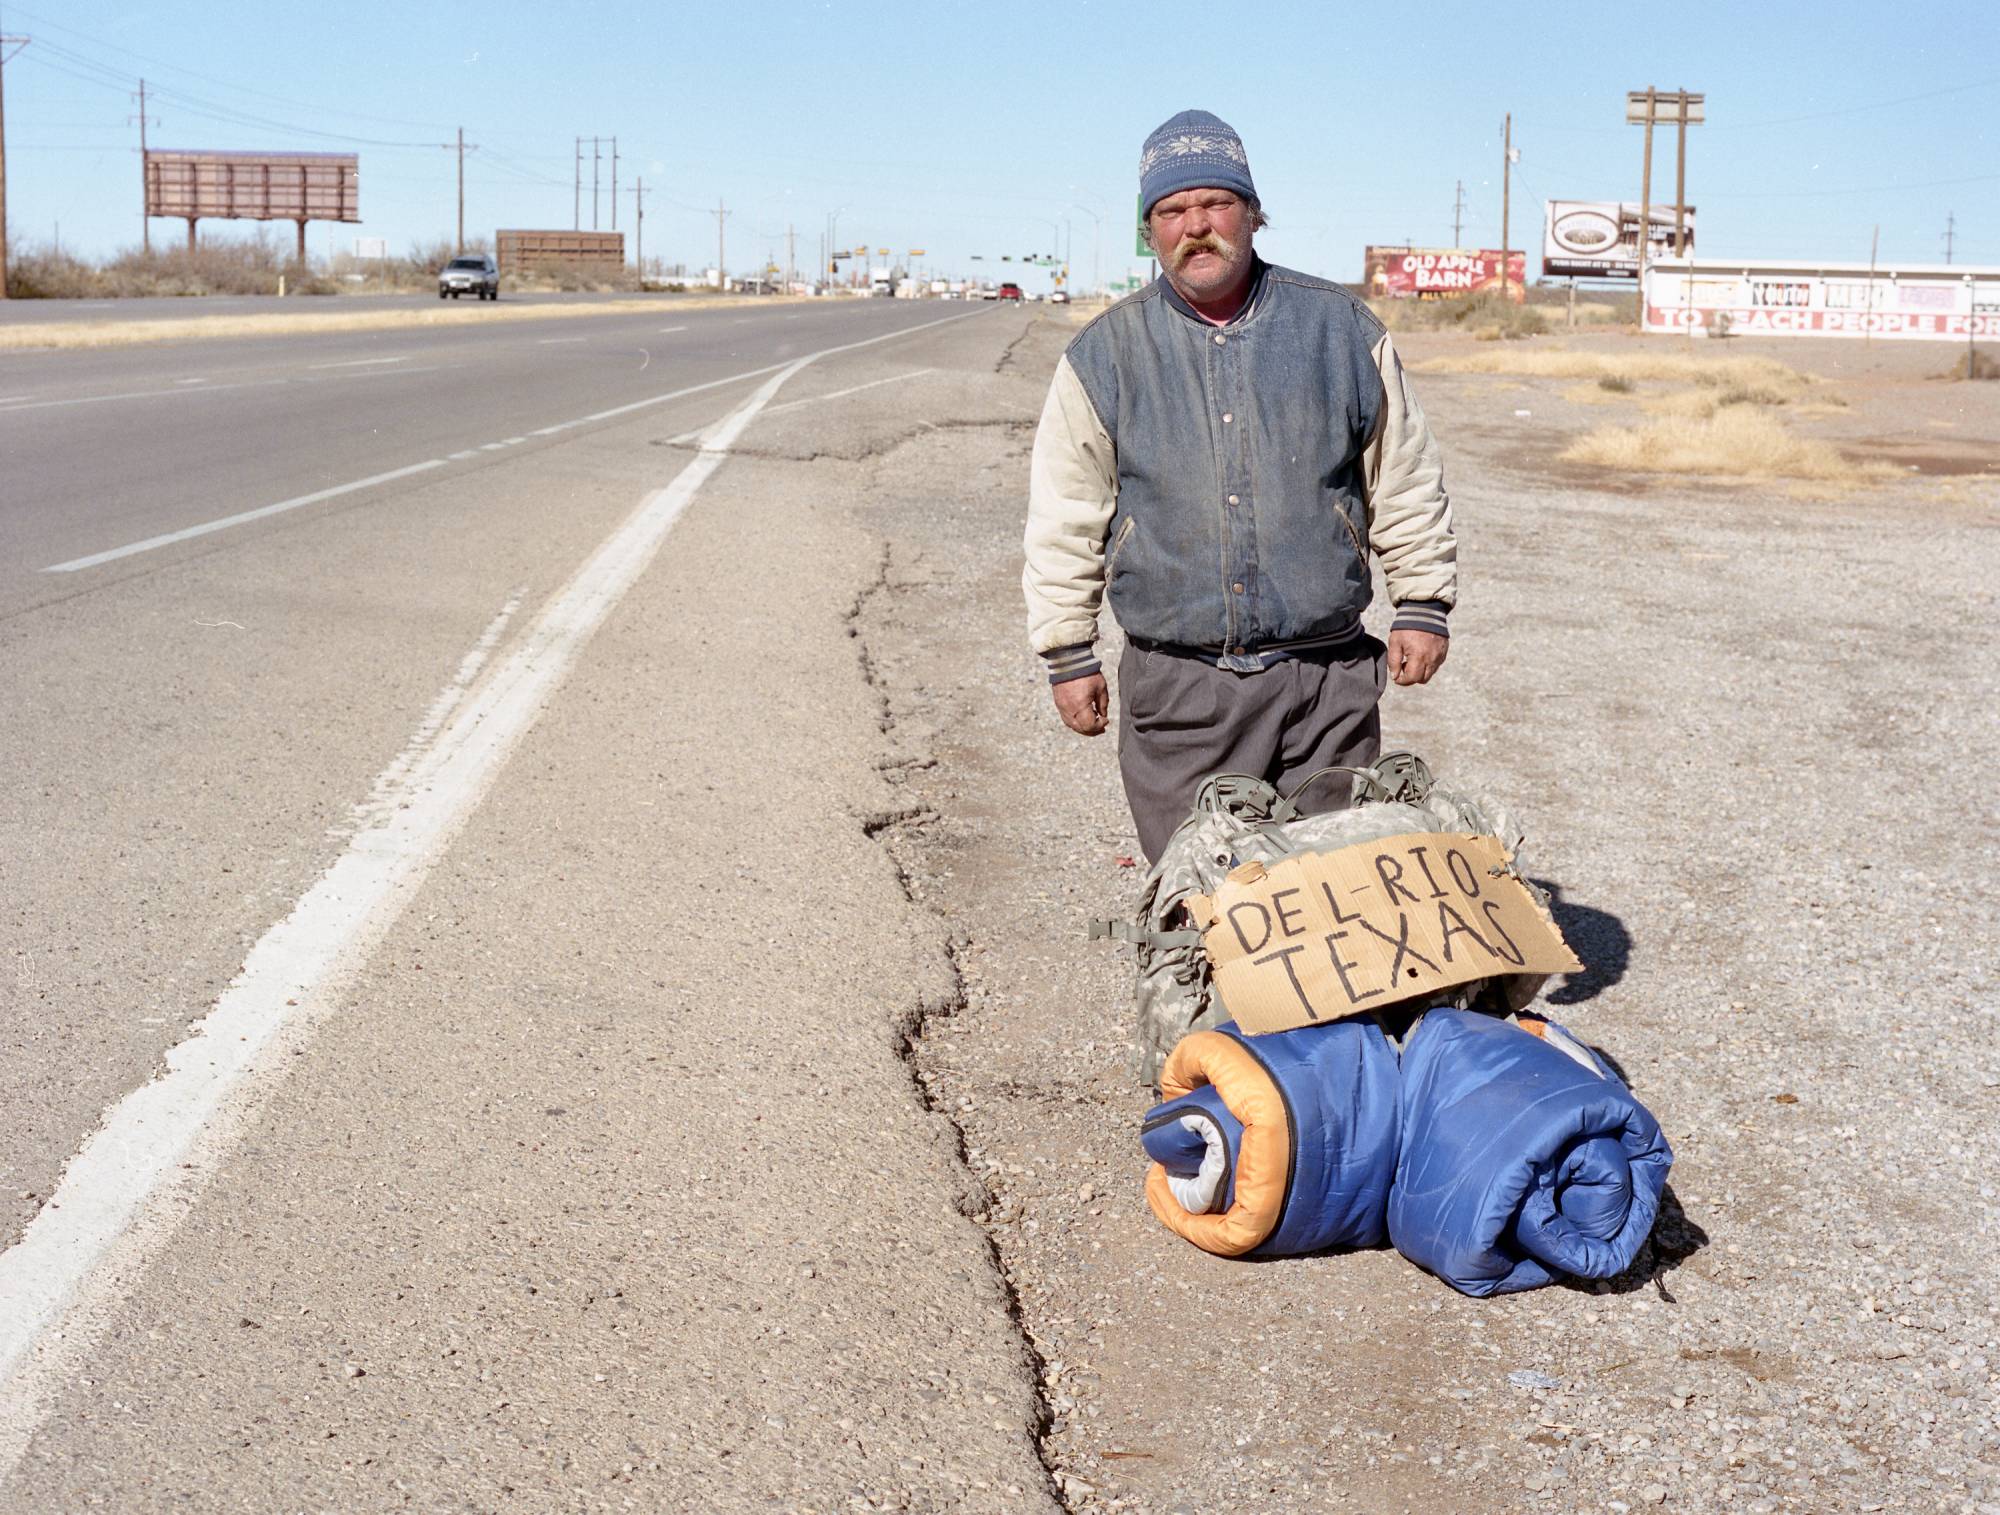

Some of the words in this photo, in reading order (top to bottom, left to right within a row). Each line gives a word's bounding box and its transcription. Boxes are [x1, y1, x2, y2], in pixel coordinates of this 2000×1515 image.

[1402, 255, 1435, 273] OLD
[1437, 255, 1486, 275] APPLE
[1415, 269, 1473, 288] BARN
[1659, 308, 1703, 327] TO
[1823, 312, 1937, 334] PEOPLE
[1948, 315, 2000, 336] FOR
[1253, 900, 1525, 1020] TEXAS
